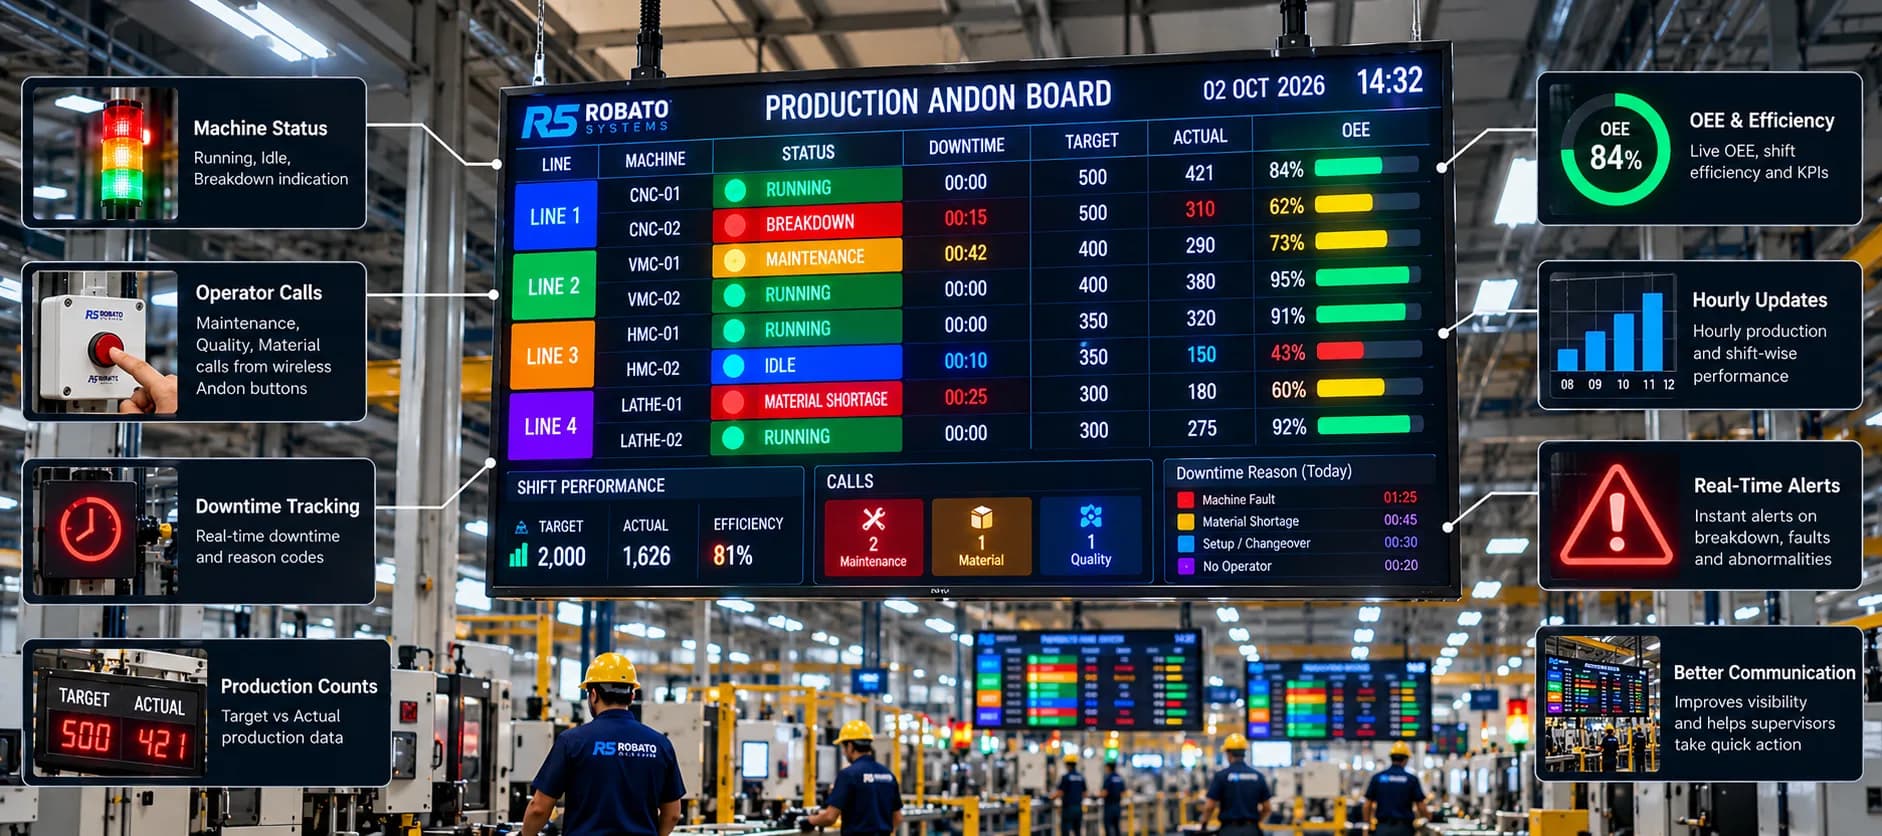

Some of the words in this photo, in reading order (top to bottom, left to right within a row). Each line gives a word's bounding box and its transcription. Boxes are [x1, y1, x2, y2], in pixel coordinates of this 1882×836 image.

[1204, 80, 1226, 100] 02
[1233, 78, 1269, 98] OCT
[1278, 75, 1325, 97] 2026
[1358, 66, 1423, 94] 14:32
[765, 87, 918, 121] PRODUCTION
[928, 84, 1014, 113] ANDON
[1027, 80, 1111, 109] BOARD
[586, 100, 669, 121] ROBATO
[586, 121, 668, 134] SYSTEMS
[1343, 122, 1370, 137] OEE
[1065, 133, 1119, 149] TARGET
[1173, 128, 1228, 144] ACTUAL
[783, 144, 835, 161] STATUS
[930, 137, 1004, 154] DOWNTIME
[543, 157, 571, 171] LINE
[626, 151, 685, 168] MACHINE
[1185, 165, 1212, 181] 421
[1270, 161, 1303, 178] 84%
[767, 180, 832, 199] RUNNING
[945, 174, 986, 190] 00:00
[630, 186, 679, 202] CNC-01
[1186, 201, 1214, 217] 310
[1270, 197, 1304, 214] 62%
[531, 208, 566, 225] LINE
[573, 207, 579, 224] 1
[767, 214, 854, 231] BREAKDOWN
[945, 209, 987, 226] 00:15
[630, 221, 680, 237] CNC-02
[1187, 237, 1215, 253] 290
[1270, 234, 1304, 251] 73%
[767, 249, 864, 266] MAINTENANCE
[945, 245, 986, 261] 00:42
[629, 256, 678, 271] VMC-01
[945, 352, 987, 368] 00:10
[1188, 346, 1216, 362] 150
[1272, 344, 1305, 360] 43%
[766, 357, 795, 373] IDLE
[765, 394, 822, 408] MATERIAL
[827, 392, 888, 408] SHORTAGE
[944, 388, 987, 407] 00:25
[526, 417, 561, 435] LINE
[567, 417, 576, 434] 4
[1177, 466, 1243, 480] Downtime
[1249, 466, 1297, 479] Reason
[1302, 464, 1351, 480] (Today)
[518, 480, 557, 494] SHIFT
[562, 478, 665, 493] PERFORMANCE
[827, 474, 873, 489] CALLS
[1203, 494, 1246, 505] Machine
[1250, 493, 1275, 504] Fault
[1384, 489, 1417, 504] 01:25
[539, 520, 583, 532] TARGET
[623, 519, 668, 531] ACTUAL
[715, 517, 783, 530] EFFICIENCY
[1203, 516, 1246, 527] Material
[1250, 516, 1299, 529] Shortage
[1385, 514, 1417, 525] 00:45
[1203, 538, 1234, 551] Setup
[1238, 538, 1242, 549] /
[1246, 538, 1310, 551] Changeover
[1385, 536, 1417, 548] 00:30
[538, 546, 585, 569] 2,000
[624, 546, 670, 568] 1,626
[714, 544, 752, 565] 81%
[841, 556, 906, 566] Maintenance
[960, 554, 1003, 567] Material
[1071, 553, 1111, 567] Quality
[1204, 561, 1219, 571] No
[1222, 560, 1272, 574] Operator
[1385, 560, 1418, 570] 00:20
[59, 688, 110, 707] TARGET
[135, 696, 185, 715] ACTUAL
[61, 719, 111, 753] 500
[139, 727, 187, 761] 421
[618, 743, 656, 753] ROBATO
